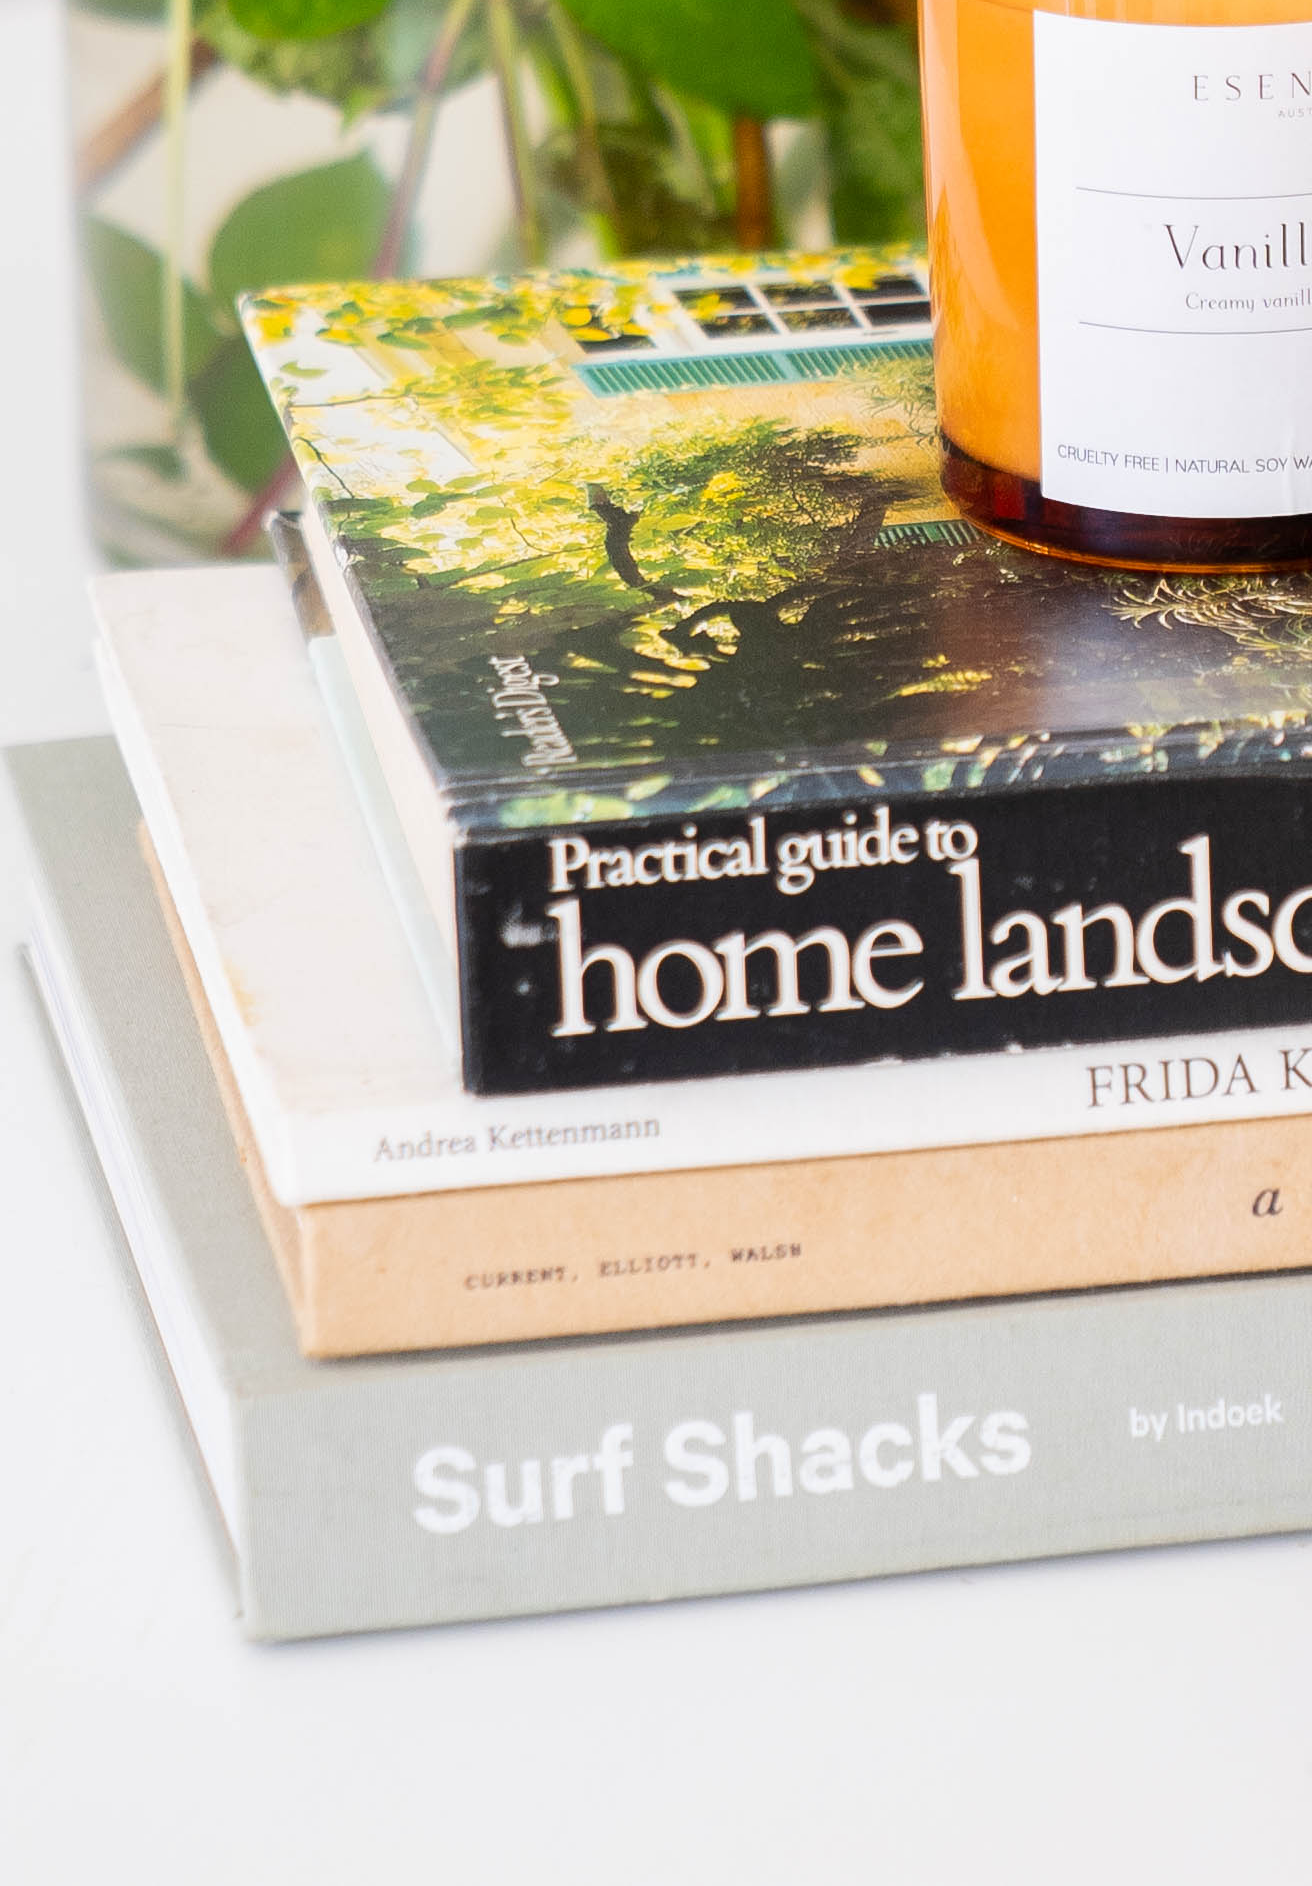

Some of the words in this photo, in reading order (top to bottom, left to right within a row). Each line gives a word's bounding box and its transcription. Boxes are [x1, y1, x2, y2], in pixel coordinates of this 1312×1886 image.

[1185, 291, 1255, 313] Creamy
[1057, 444, 1119, 467] CRUELTY
[1124, 454, 1160, 472] FREE
[1175, 458, 1250, 475] NATURAL
[1255, 457, 1288, 473] SOY
[487, 655, 560, 708] Digest
[494, 706, 577, 767] Reader's
[548, 816, 767, 892] Practical
[777, 804, 917, 895] guide
[925, 820, 979, 863] to
[548, 898, 924, 1038] home
[1086, 1053, 1260, 1108] FRIDA
[373, 1130, 477, 1162] Andrea
[487, 1116, 661, 1152] Kettenmann
[1251, 1186, 1283, 1217] a
[463, 1264, 580, 1291] CURRENT,
[600, 1253, 711, 1278] ELLIOTT,
[731, 1243, 802, 1263] WALSH
[1128, 1407, 1170, 1442] by
[1177, 1393, 1284, 1434] Indoek
[412, 1423, 634, 1535] Surf
[663, 1393, 1033, 1508] Shacks
